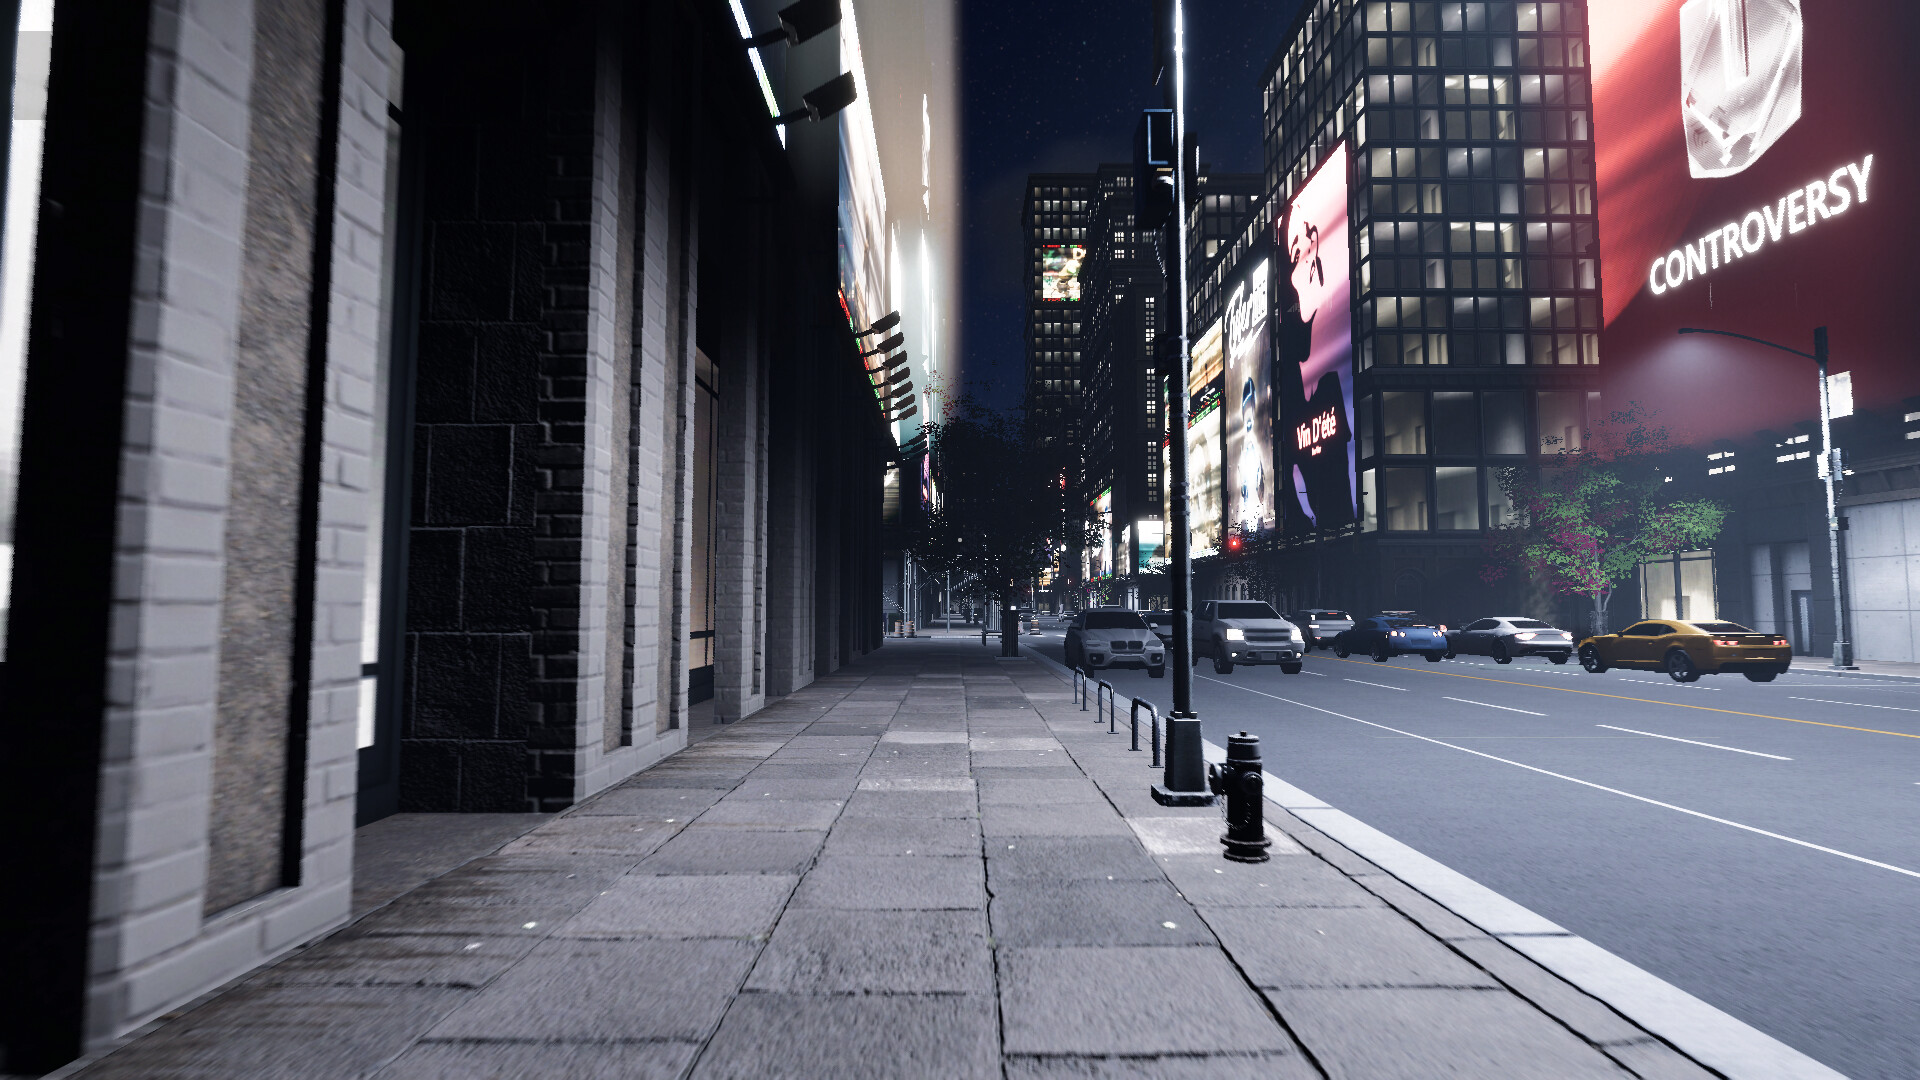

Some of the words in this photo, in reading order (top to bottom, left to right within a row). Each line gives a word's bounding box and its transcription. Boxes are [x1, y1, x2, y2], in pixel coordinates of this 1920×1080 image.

[1649, 154, 1873, 295] CONTROVERSY
[1296, 422, 1311, 450] Vin
[1312, 406, 1336, 443] D'été
